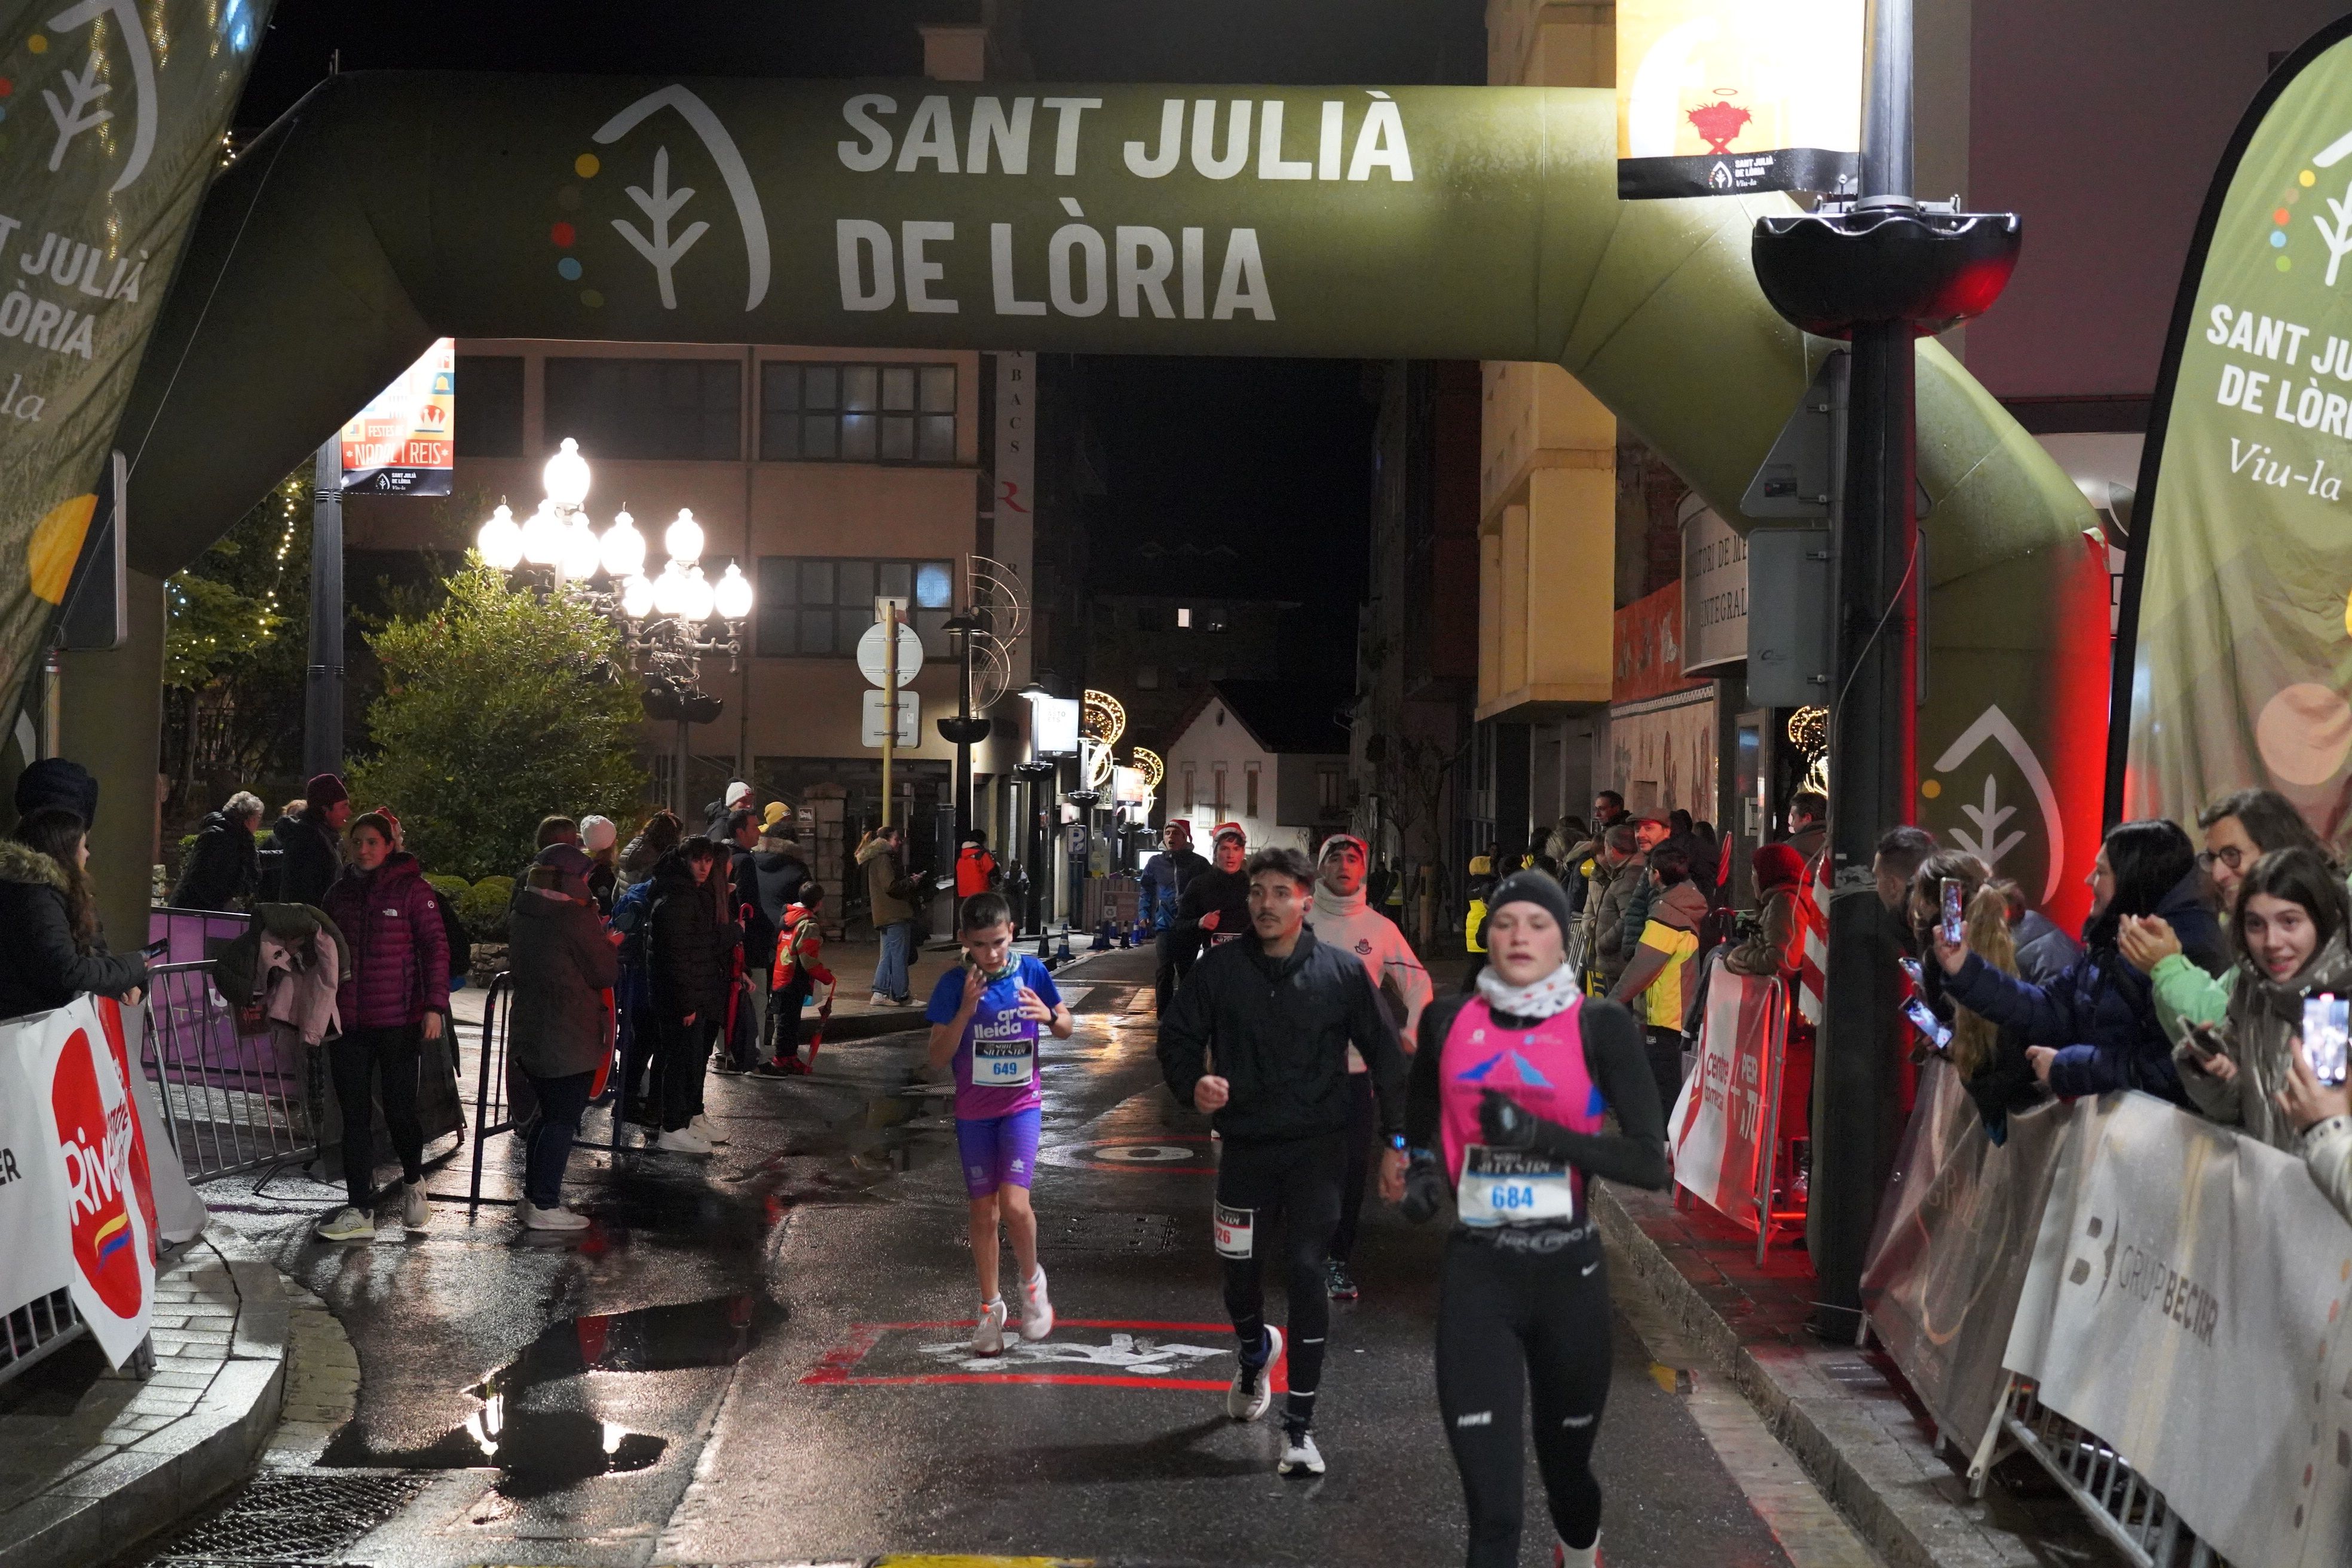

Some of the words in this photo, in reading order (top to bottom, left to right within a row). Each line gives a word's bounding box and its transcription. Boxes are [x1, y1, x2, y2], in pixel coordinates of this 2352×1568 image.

[838, 94, 1102, 175] SANT
[1124, 91, 1413, 182] JULIÀ
[1735, 158, 1754, 169] SANT
[1735, 169, 1744, 177] DE
[20, 232, 148, 302] JULIÀ
[837, 219, 958, 314] DE
[991, 197, 1276, 321] LÒRIA
[2207, 304, 2310, 365] SANT
[2218, 364, 2270, 414] DE
[354, 443, 397, 466] NADAL
[410, 442, 441, 464] REIS
[2231, 437, 2341, 501] Viu-la
[1718, 539, 1729, 568] DE
[1701, 587, 1747, 627] INTEGRAL
[974, 1022, 1021, 1039] lleida
[993, 1062, 1017, 1075] 649
[1707, 1051, 1729, 1085] centre
[1741, 1052, 1758, 1086] PER
[1492, 1185, 1533, 1208] 684
